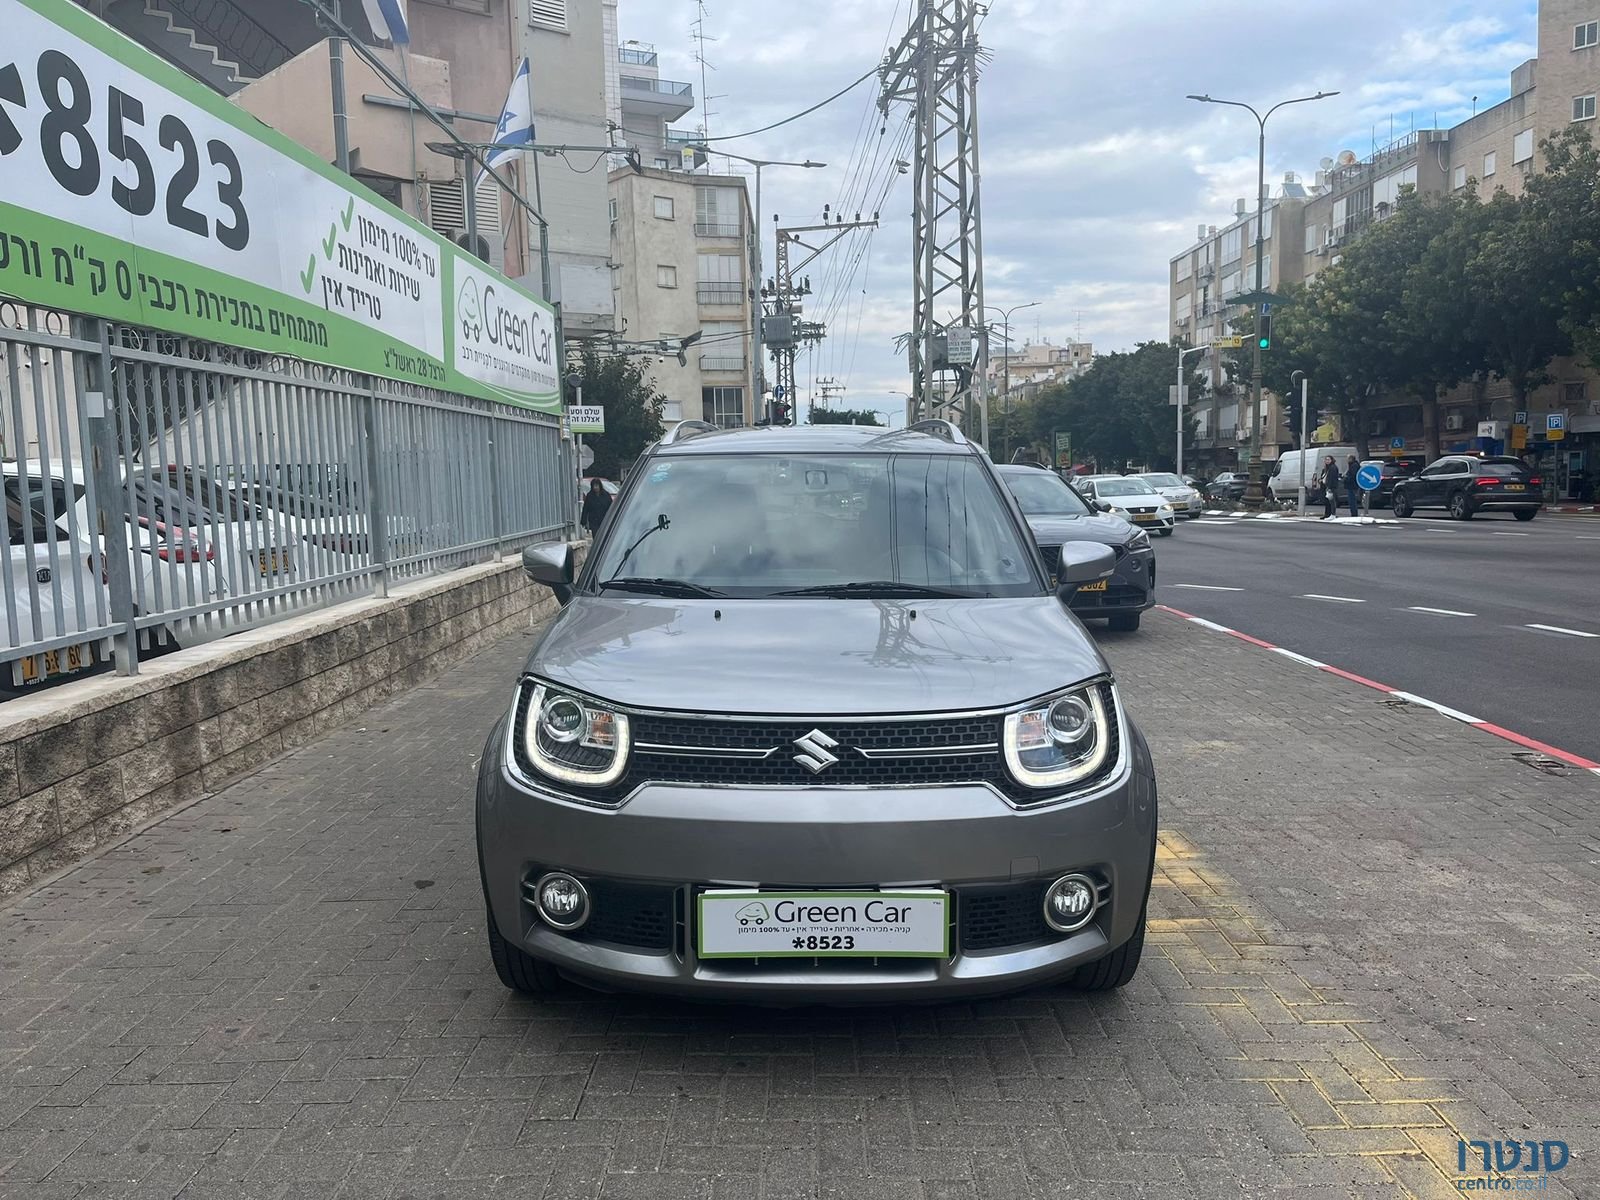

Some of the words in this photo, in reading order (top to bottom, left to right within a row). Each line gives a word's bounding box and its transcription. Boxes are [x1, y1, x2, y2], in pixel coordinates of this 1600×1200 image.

[358, 215, 390, 254] מימון
[392, 232, 421, 270] 100%
[115, 260, 131, 301] 0
[338, 242, 387, 287] ואמינות
[422, 252, 435, 278] עד
[138, 272, 190, 315] רכבי
[321, 275, 344, 311] אין
[388, 267, 420, 301] שירות
[194, 288, 265, 332] במכירת
[347, 285, 381, 320] טרייד
[268, 308, 328, 348] מתמחים
[484, 285, 530, 357] Green
[532, 311, 552, 366] Car
[417, 356, 427, 377] 28
[462, 346, 473, 361] רכב
[428, 360, 446, 382] הרצל
[581, 415, 600, 423] אצלנו
[774, 900, 857, 924] Green
[864, 900, 912, 924] Car
[738, 926, 757, 935] מימון
[796, 926, 807, 934] אין
[894, 926, 911, 934] קניה
